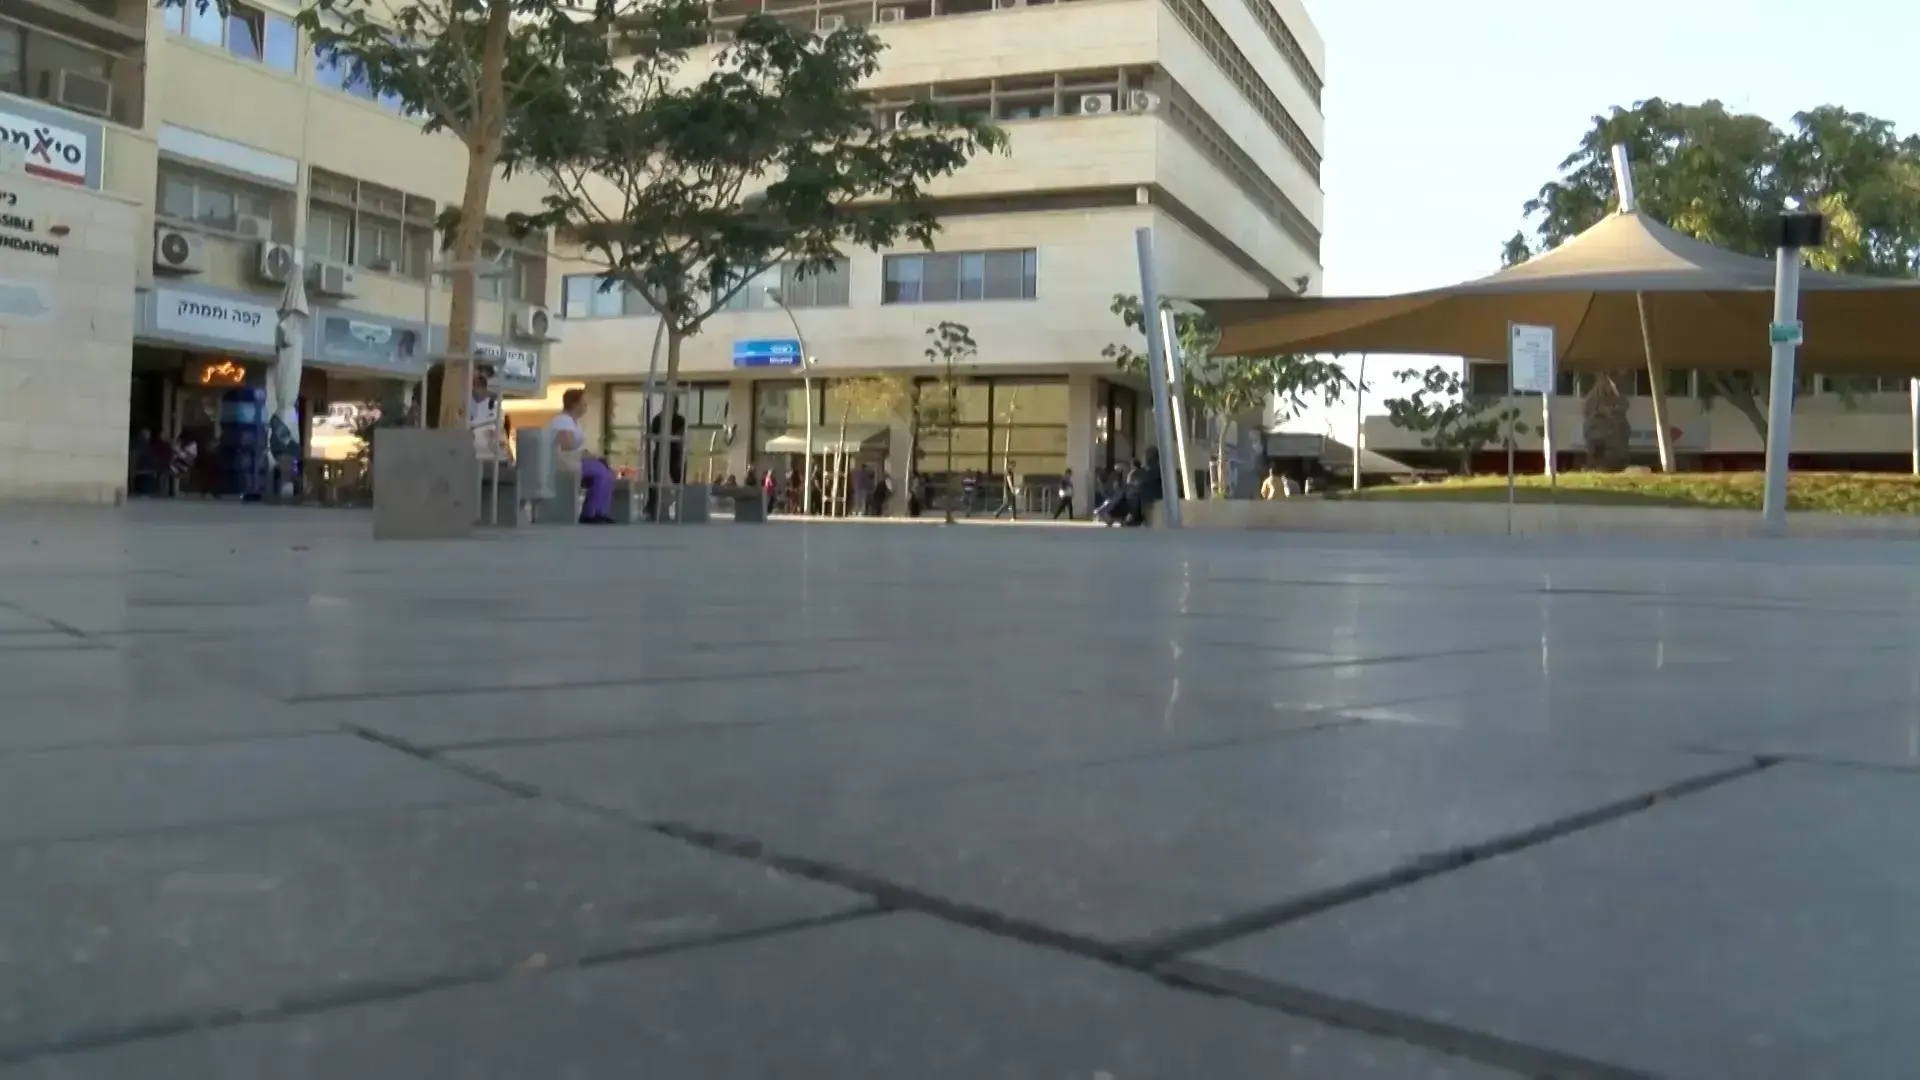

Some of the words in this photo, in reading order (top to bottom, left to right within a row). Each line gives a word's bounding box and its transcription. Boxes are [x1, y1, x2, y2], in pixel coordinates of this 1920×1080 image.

[0, 213, 34, 232] SIBLE
[177, 300, 227, 320] וממתק
[232, 309, 261, 328] קפה
